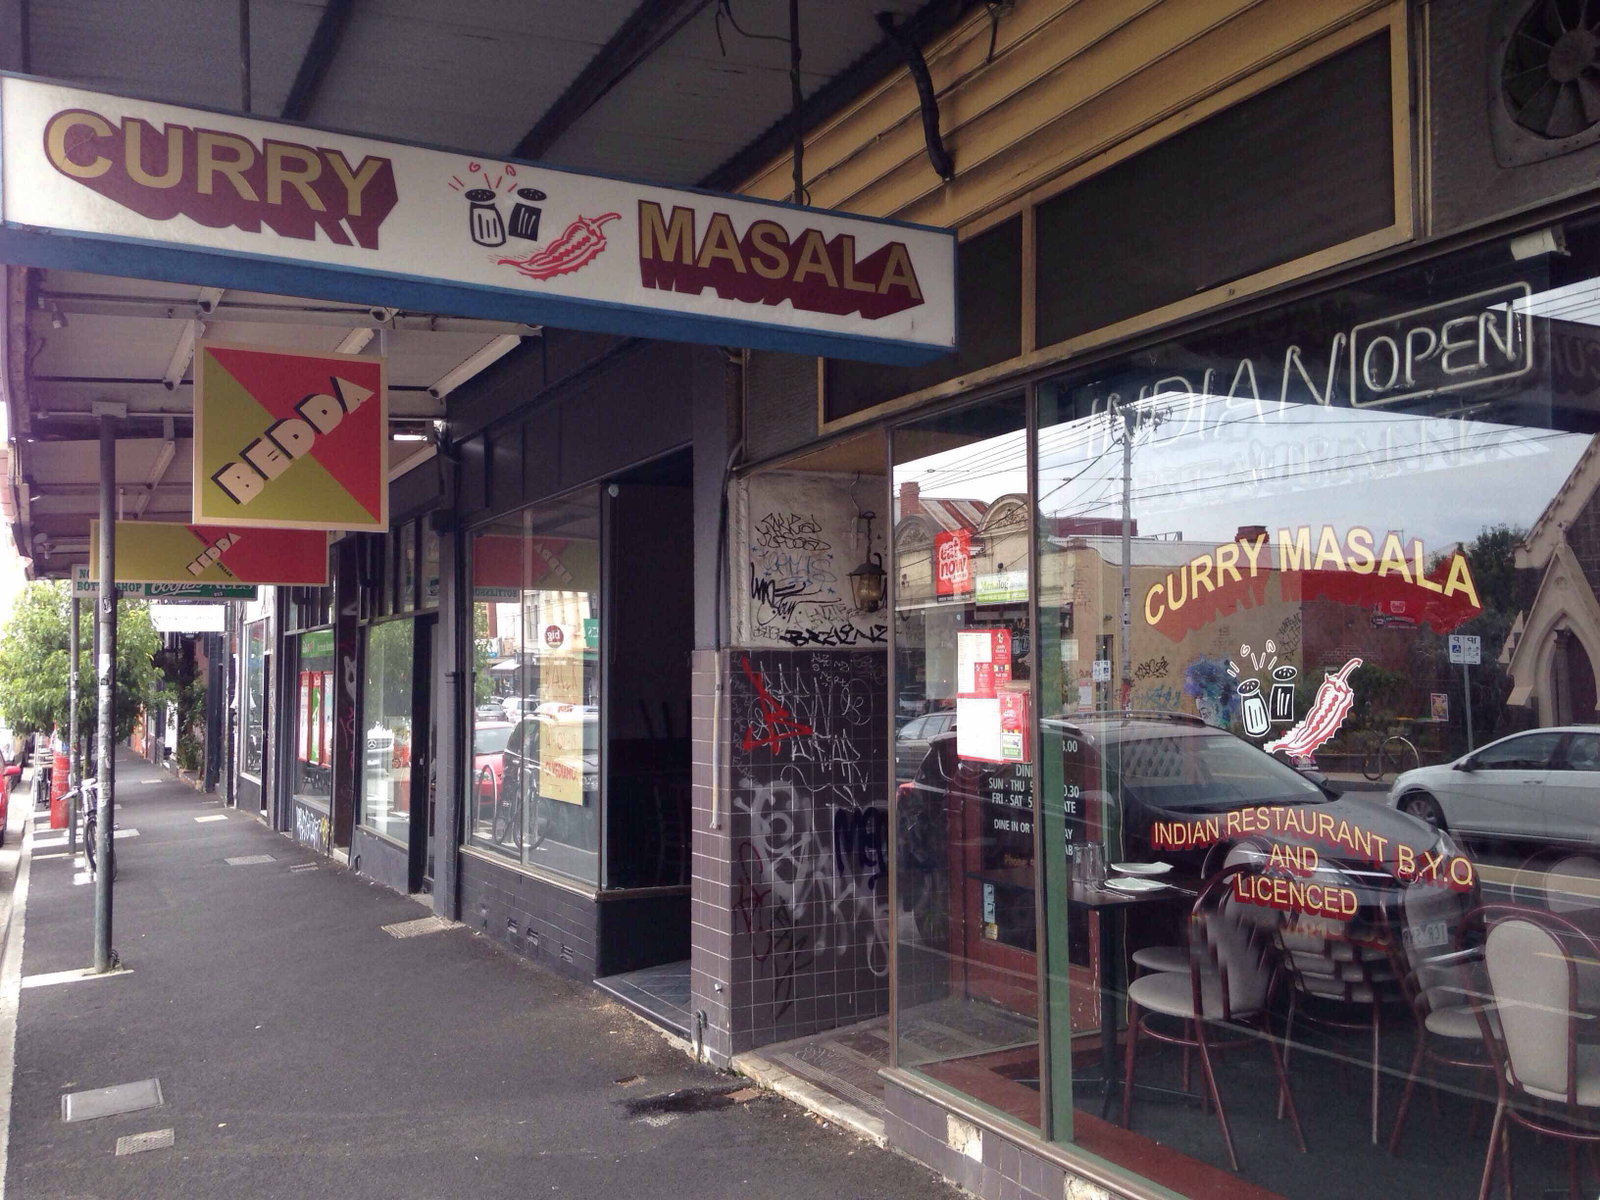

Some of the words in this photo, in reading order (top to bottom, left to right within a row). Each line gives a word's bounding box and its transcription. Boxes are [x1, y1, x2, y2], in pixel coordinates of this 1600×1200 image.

[44, 109, 391, 232] CURRY
[639, 200, 923, 308] MASALA
[1363, 301, 1520, 392] OPEN
[1088, 332, 1347, 459] INDIAN
[211, 376, 375, 505] BEDDA
[1144, 533, 1267, 626] CURRY
[1277, 526, 1481, 609] MASALA
[989, 777, 1004, 790] SUN
[1010, 780, 1025, 792] THU
[992, 792, 1004, 805] FRI
[1009, 794, 1023, 807] SAT
[994, 818, 1010, 831] DINE
[1011, 820, 1019, 832] IN
[1020, 822, 1030, 834] OR
[1154, 815, 1220, 846] INDIAN
[1226, 806, 1388, 863] RESTAURANT
[1270, 843, 1319, 872] AND
[1236, 875, 1358, 915] LICENCED
